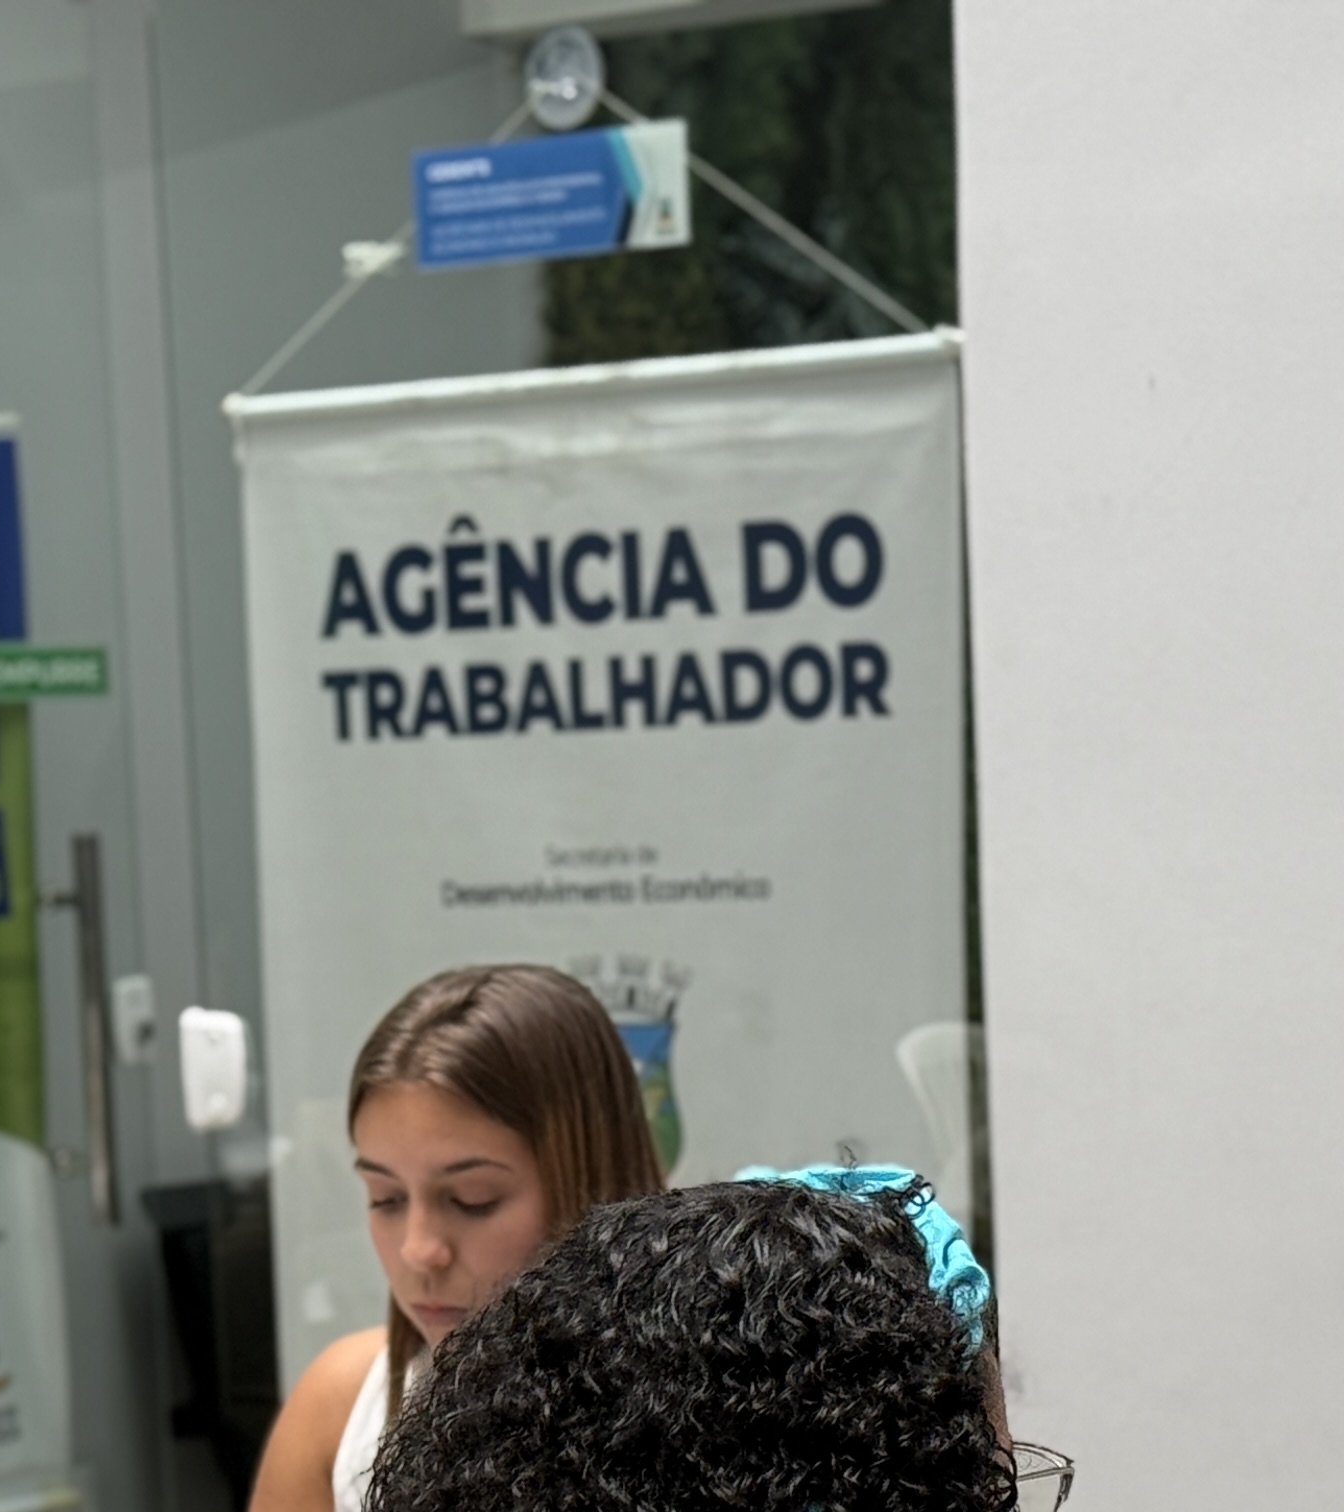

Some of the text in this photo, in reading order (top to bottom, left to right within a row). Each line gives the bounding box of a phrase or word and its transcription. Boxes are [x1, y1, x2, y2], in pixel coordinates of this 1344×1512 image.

[322, 513, 884, 640] AGÊNCIA DO
[320, 641, 892, 743] TRABALHADOR
